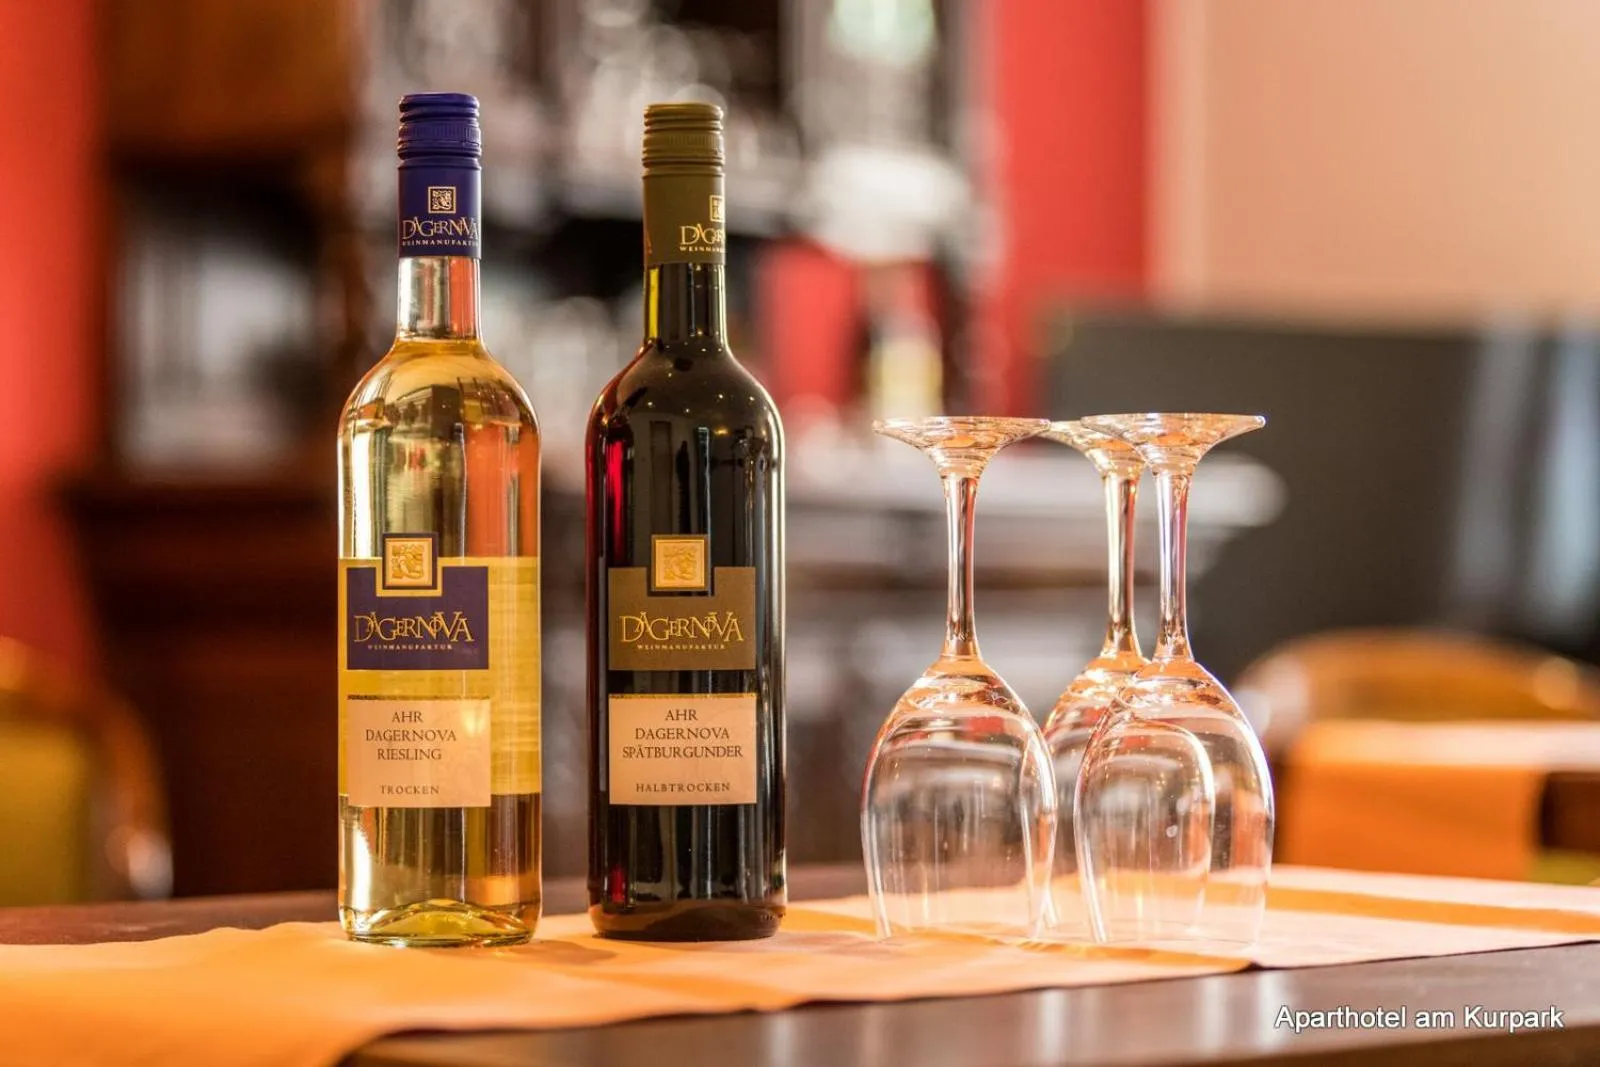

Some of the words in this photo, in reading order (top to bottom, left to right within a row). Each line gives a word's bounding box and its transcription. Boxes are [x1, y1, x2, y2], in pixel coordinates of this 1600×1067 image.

[354, 611, 474, 642] DAGERNOVA
[619, 611, 744, 642] DAGERNOVA
[392, 711, 423, 722] AHR
[665, 709, 698, 721] AHR
[365, 729, 457, 741] DAGERNOVA
[635, 728, 730, 740] DAGERNOVA
[377, 748, 442, 760] RIESLING
[622, 745, 743, 758] SPÄTBURGUNDER
[380, 785, 440, 794] TROCKEN
[636, 782, 730, 792] HALBTROCKEN
